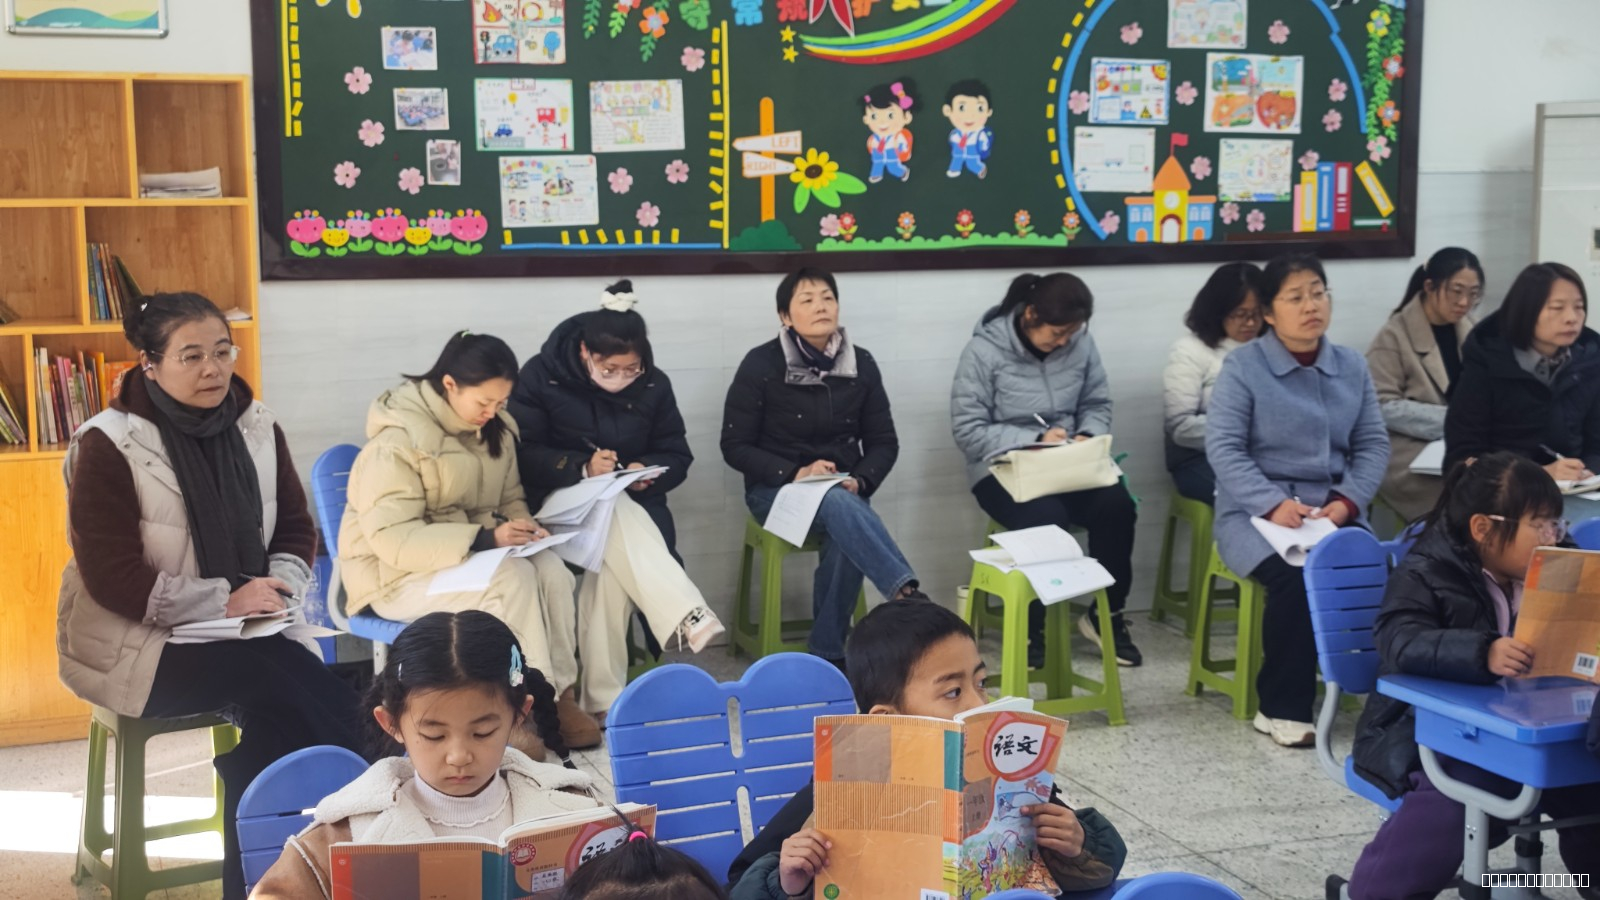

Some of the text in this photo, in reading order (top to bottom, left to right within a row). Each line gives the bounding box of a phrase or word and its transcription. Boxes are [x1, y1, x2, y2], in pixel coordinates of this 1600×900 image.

[771, 135, 799, 150] LEFT
[745, 161, 777, 172] RIGHT
[993, 734, 1038, 757] 语文
